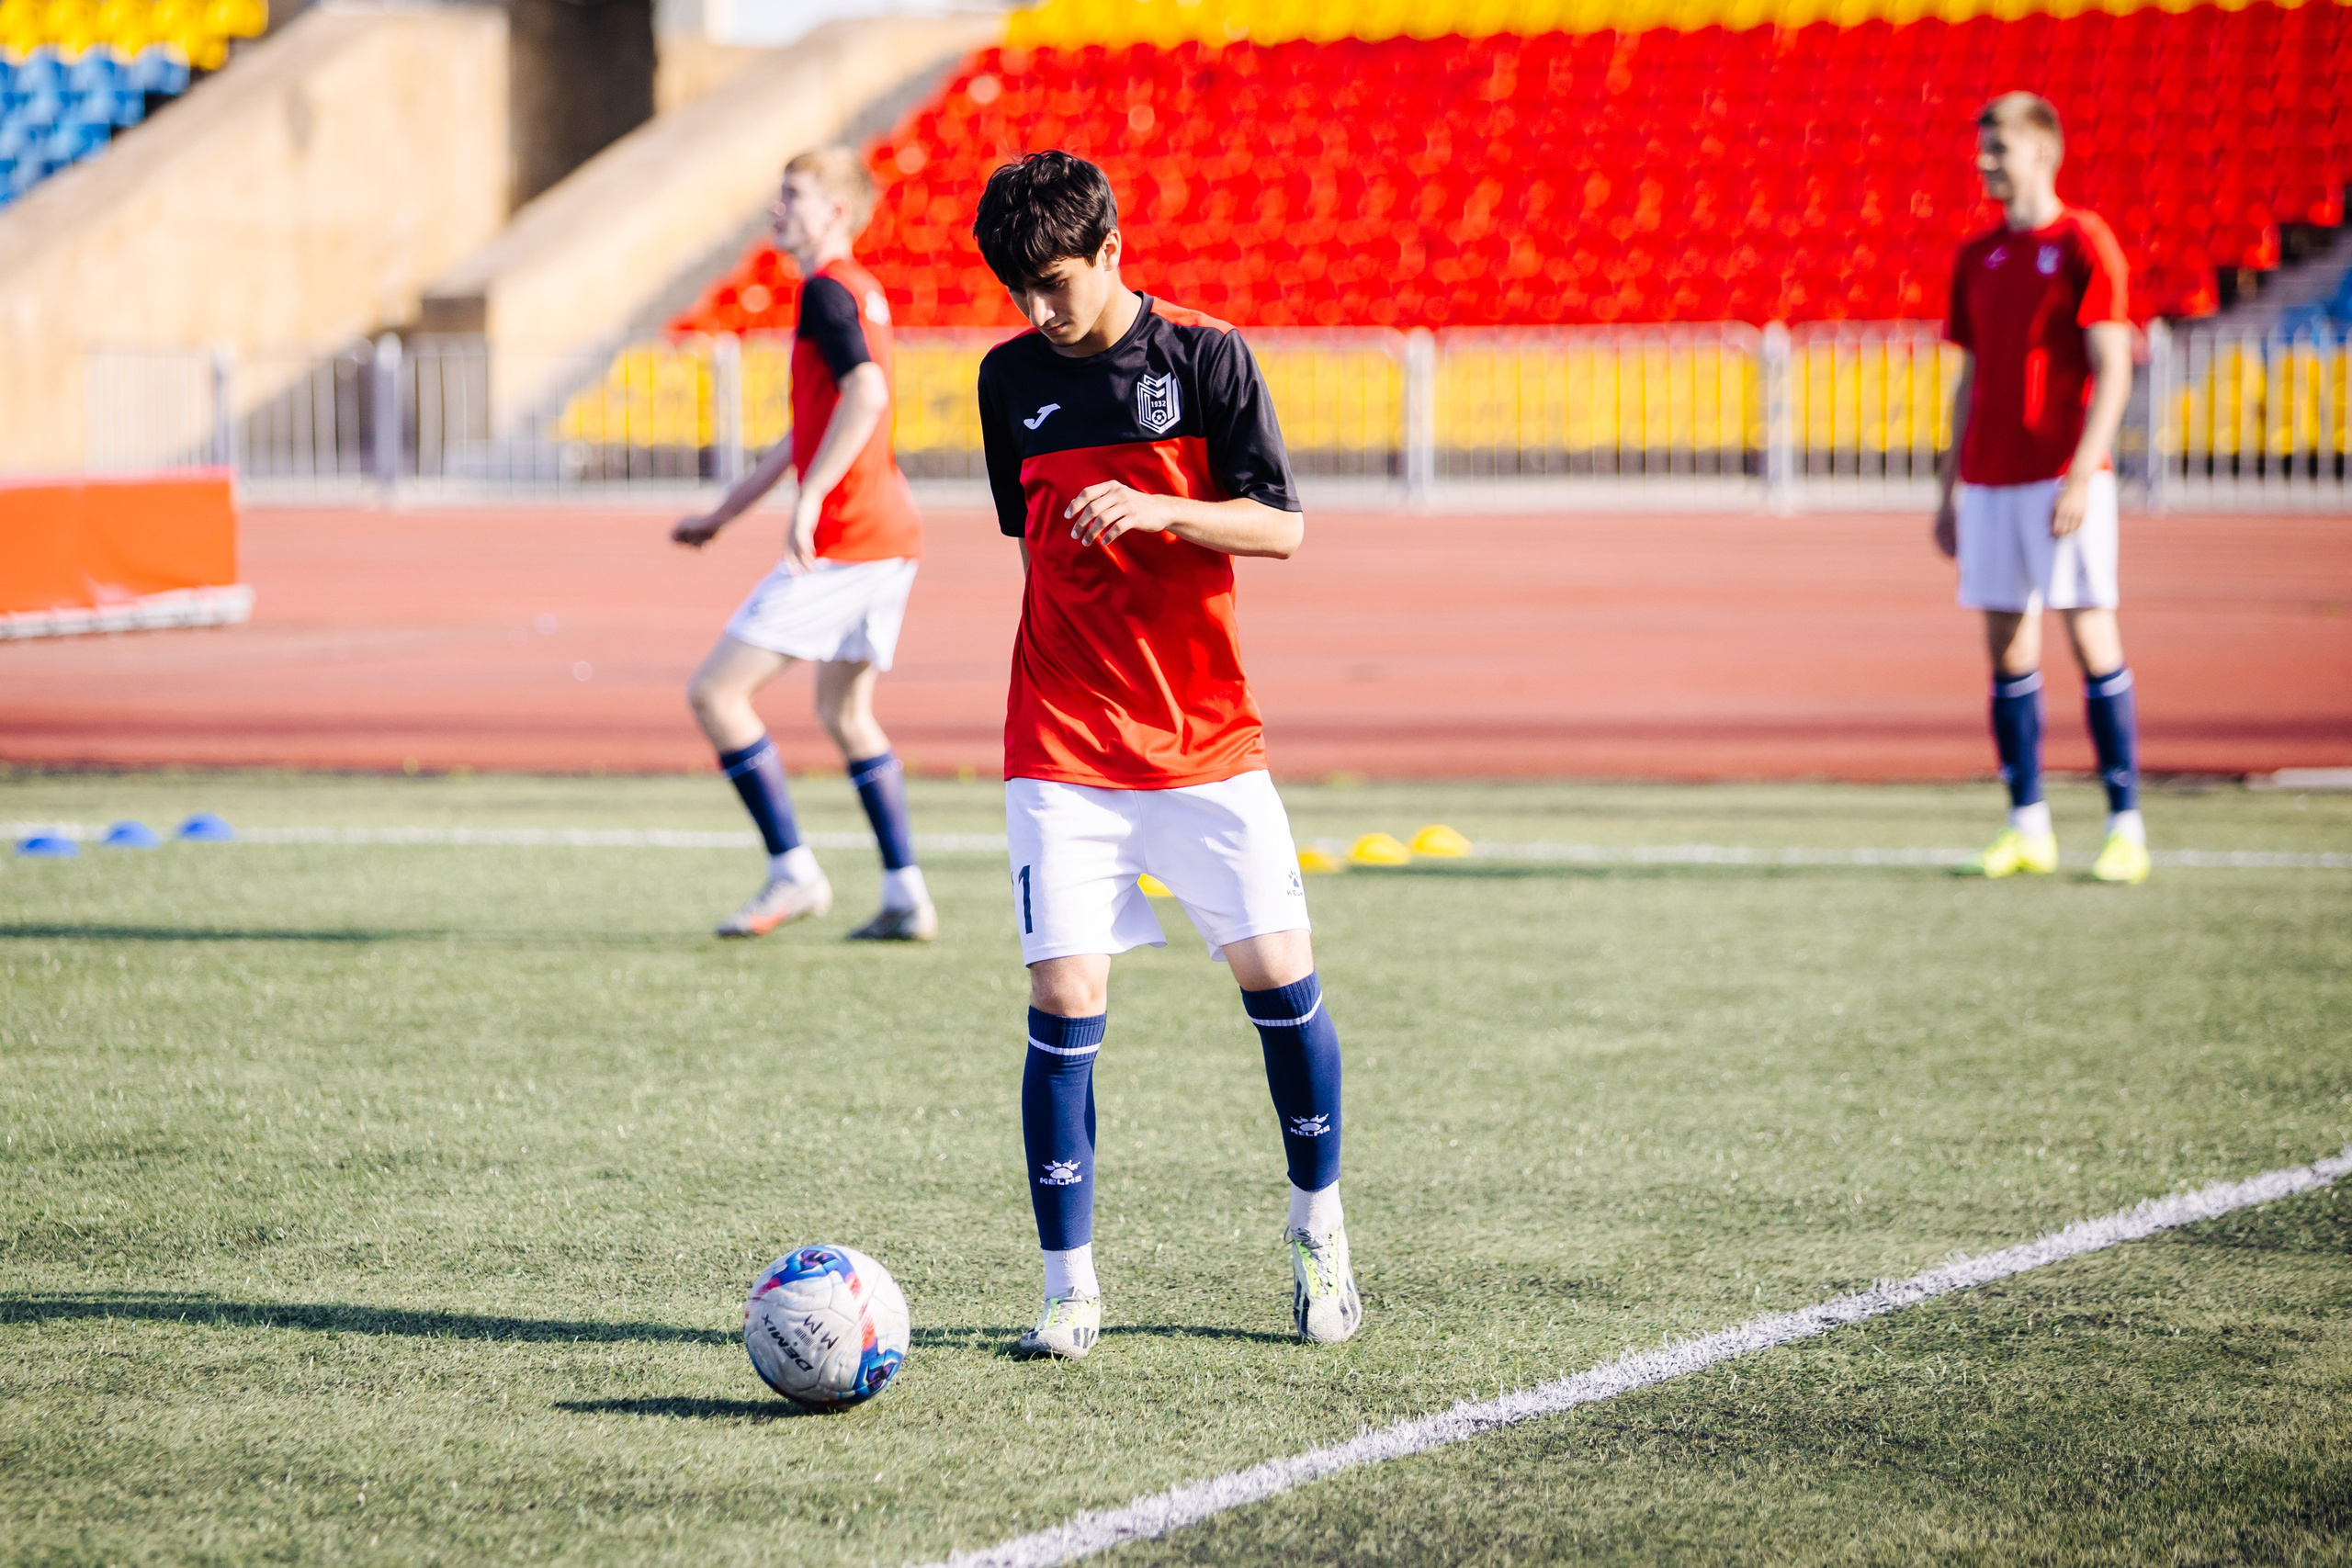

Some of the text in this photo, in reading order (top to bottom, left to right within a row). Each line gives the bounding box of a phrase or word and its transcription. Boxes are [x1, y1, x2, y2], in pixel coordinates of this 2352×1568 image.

[1150, 400, 1167, 408] 1932
[1290, 1124, 1330, 1137] KELME
[1039, 1174, 1082, 1186] KELME
[761, 1313, 815, 1373] DEMIX
